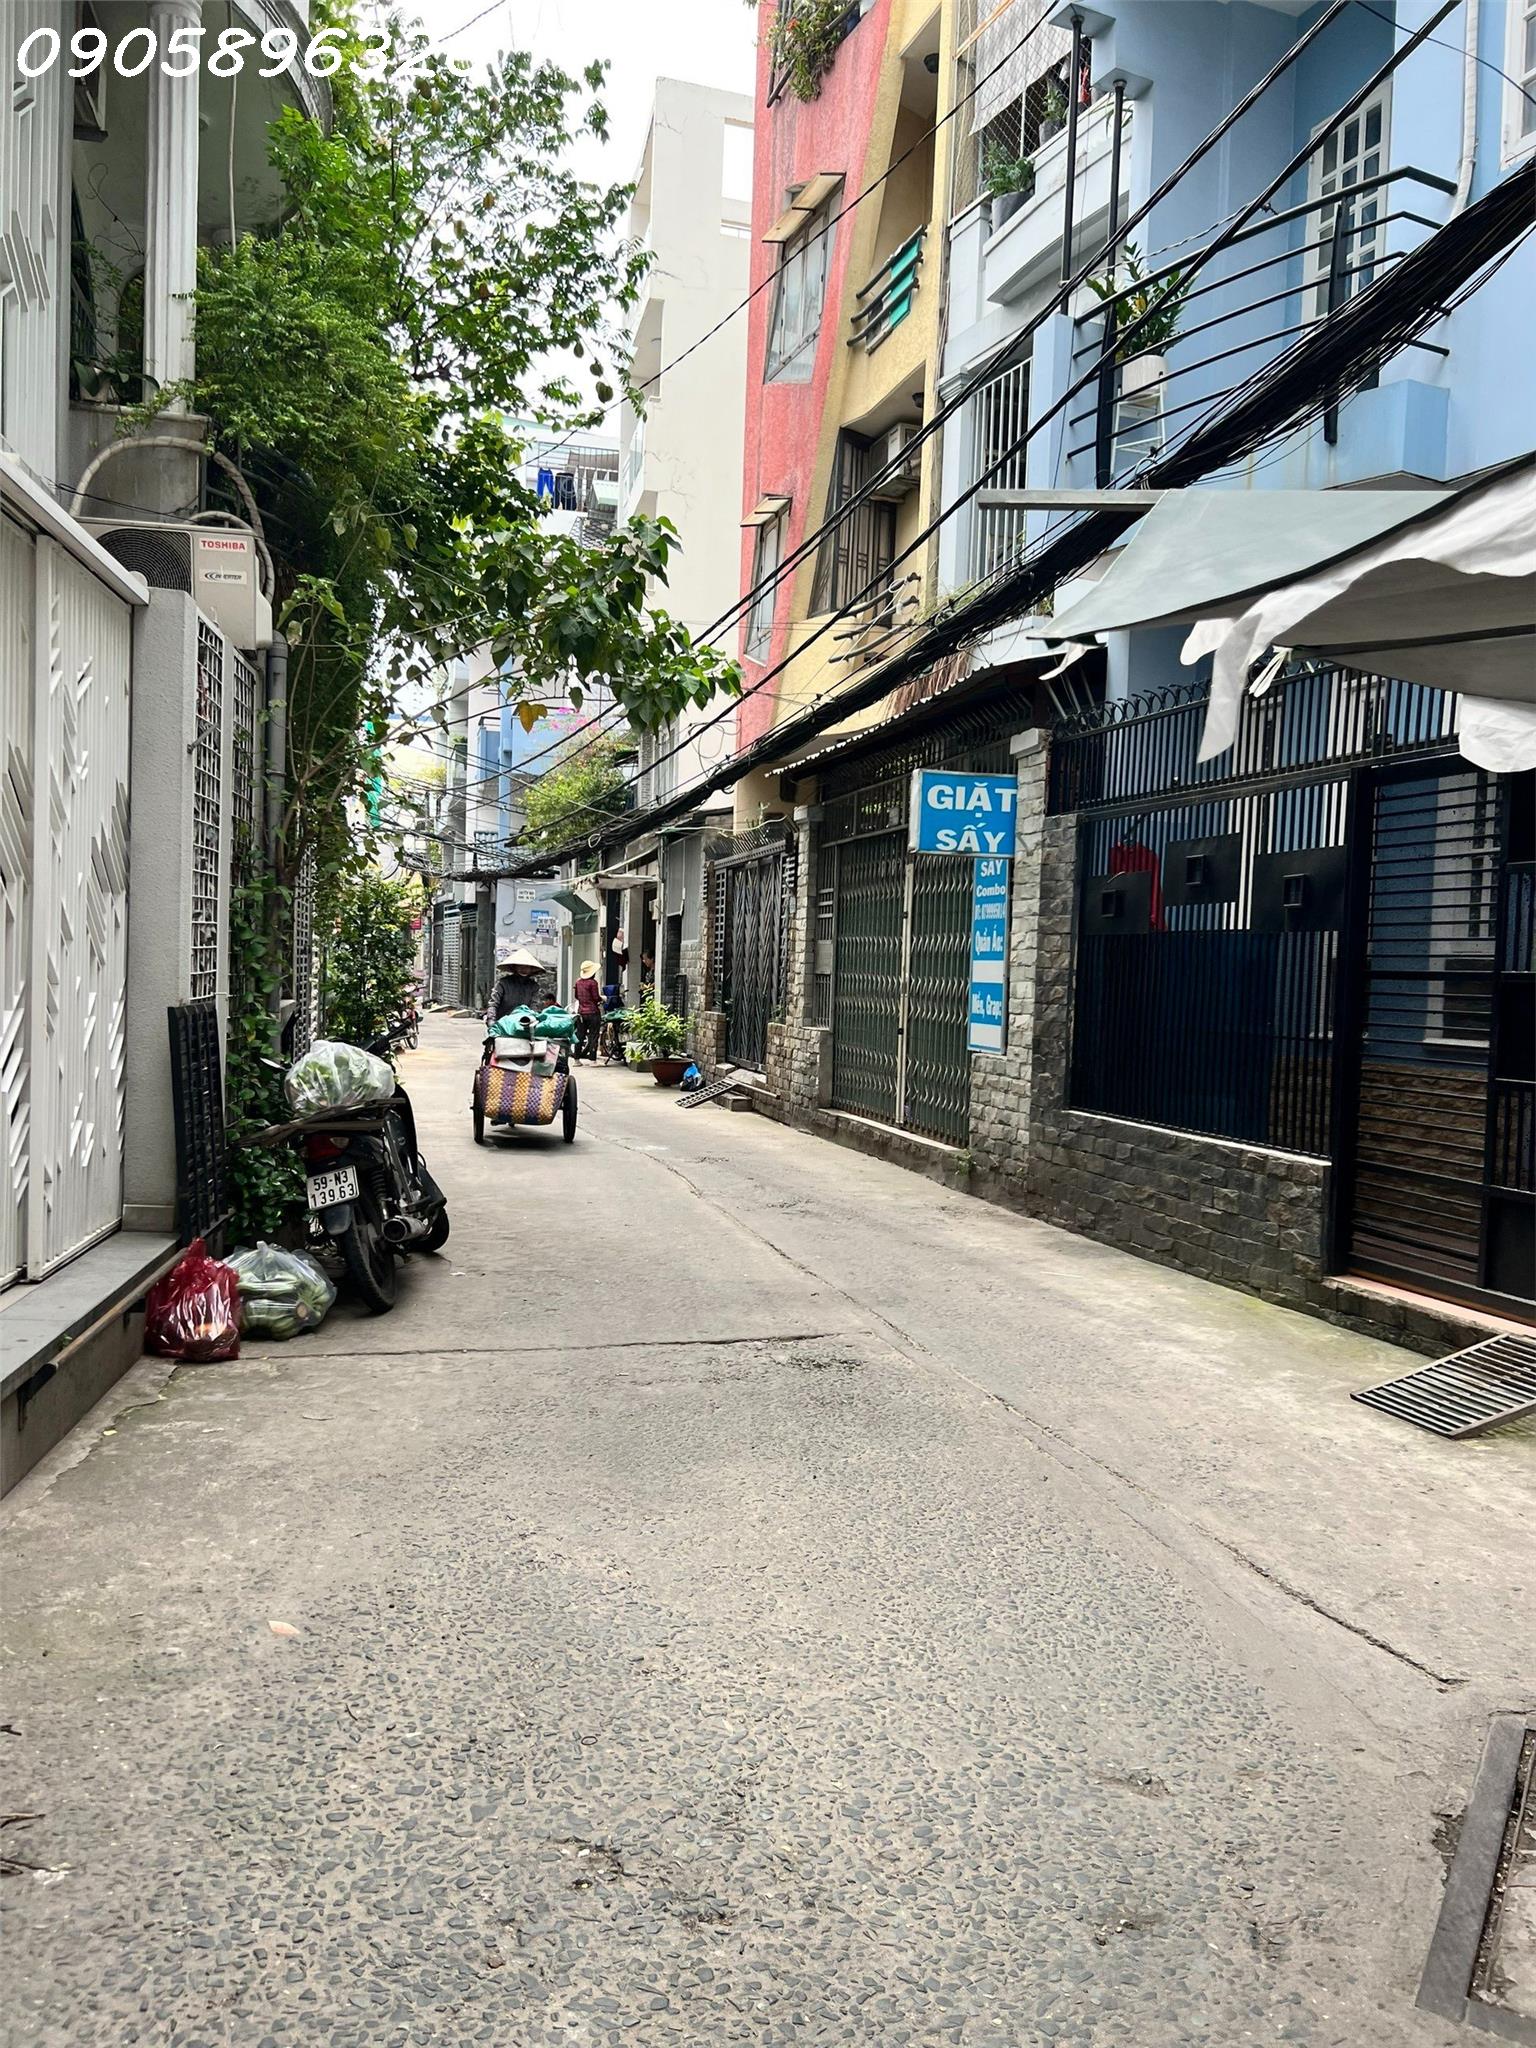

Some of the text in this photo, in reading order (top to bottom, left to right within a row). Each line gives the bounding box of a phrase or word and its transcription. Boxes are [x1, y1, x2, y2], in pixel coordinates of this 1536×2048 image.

[201, 540, 245, 550] TOSHIBA
[927, 782, 1018, 818] GIẶT
[936, 822, 1006, 853] SẤY
[976, 883, 1006, 897] Combo
[313, 1170, 348, 1191] 59-N3
[311, 1183, 355, 1207] 139.63
